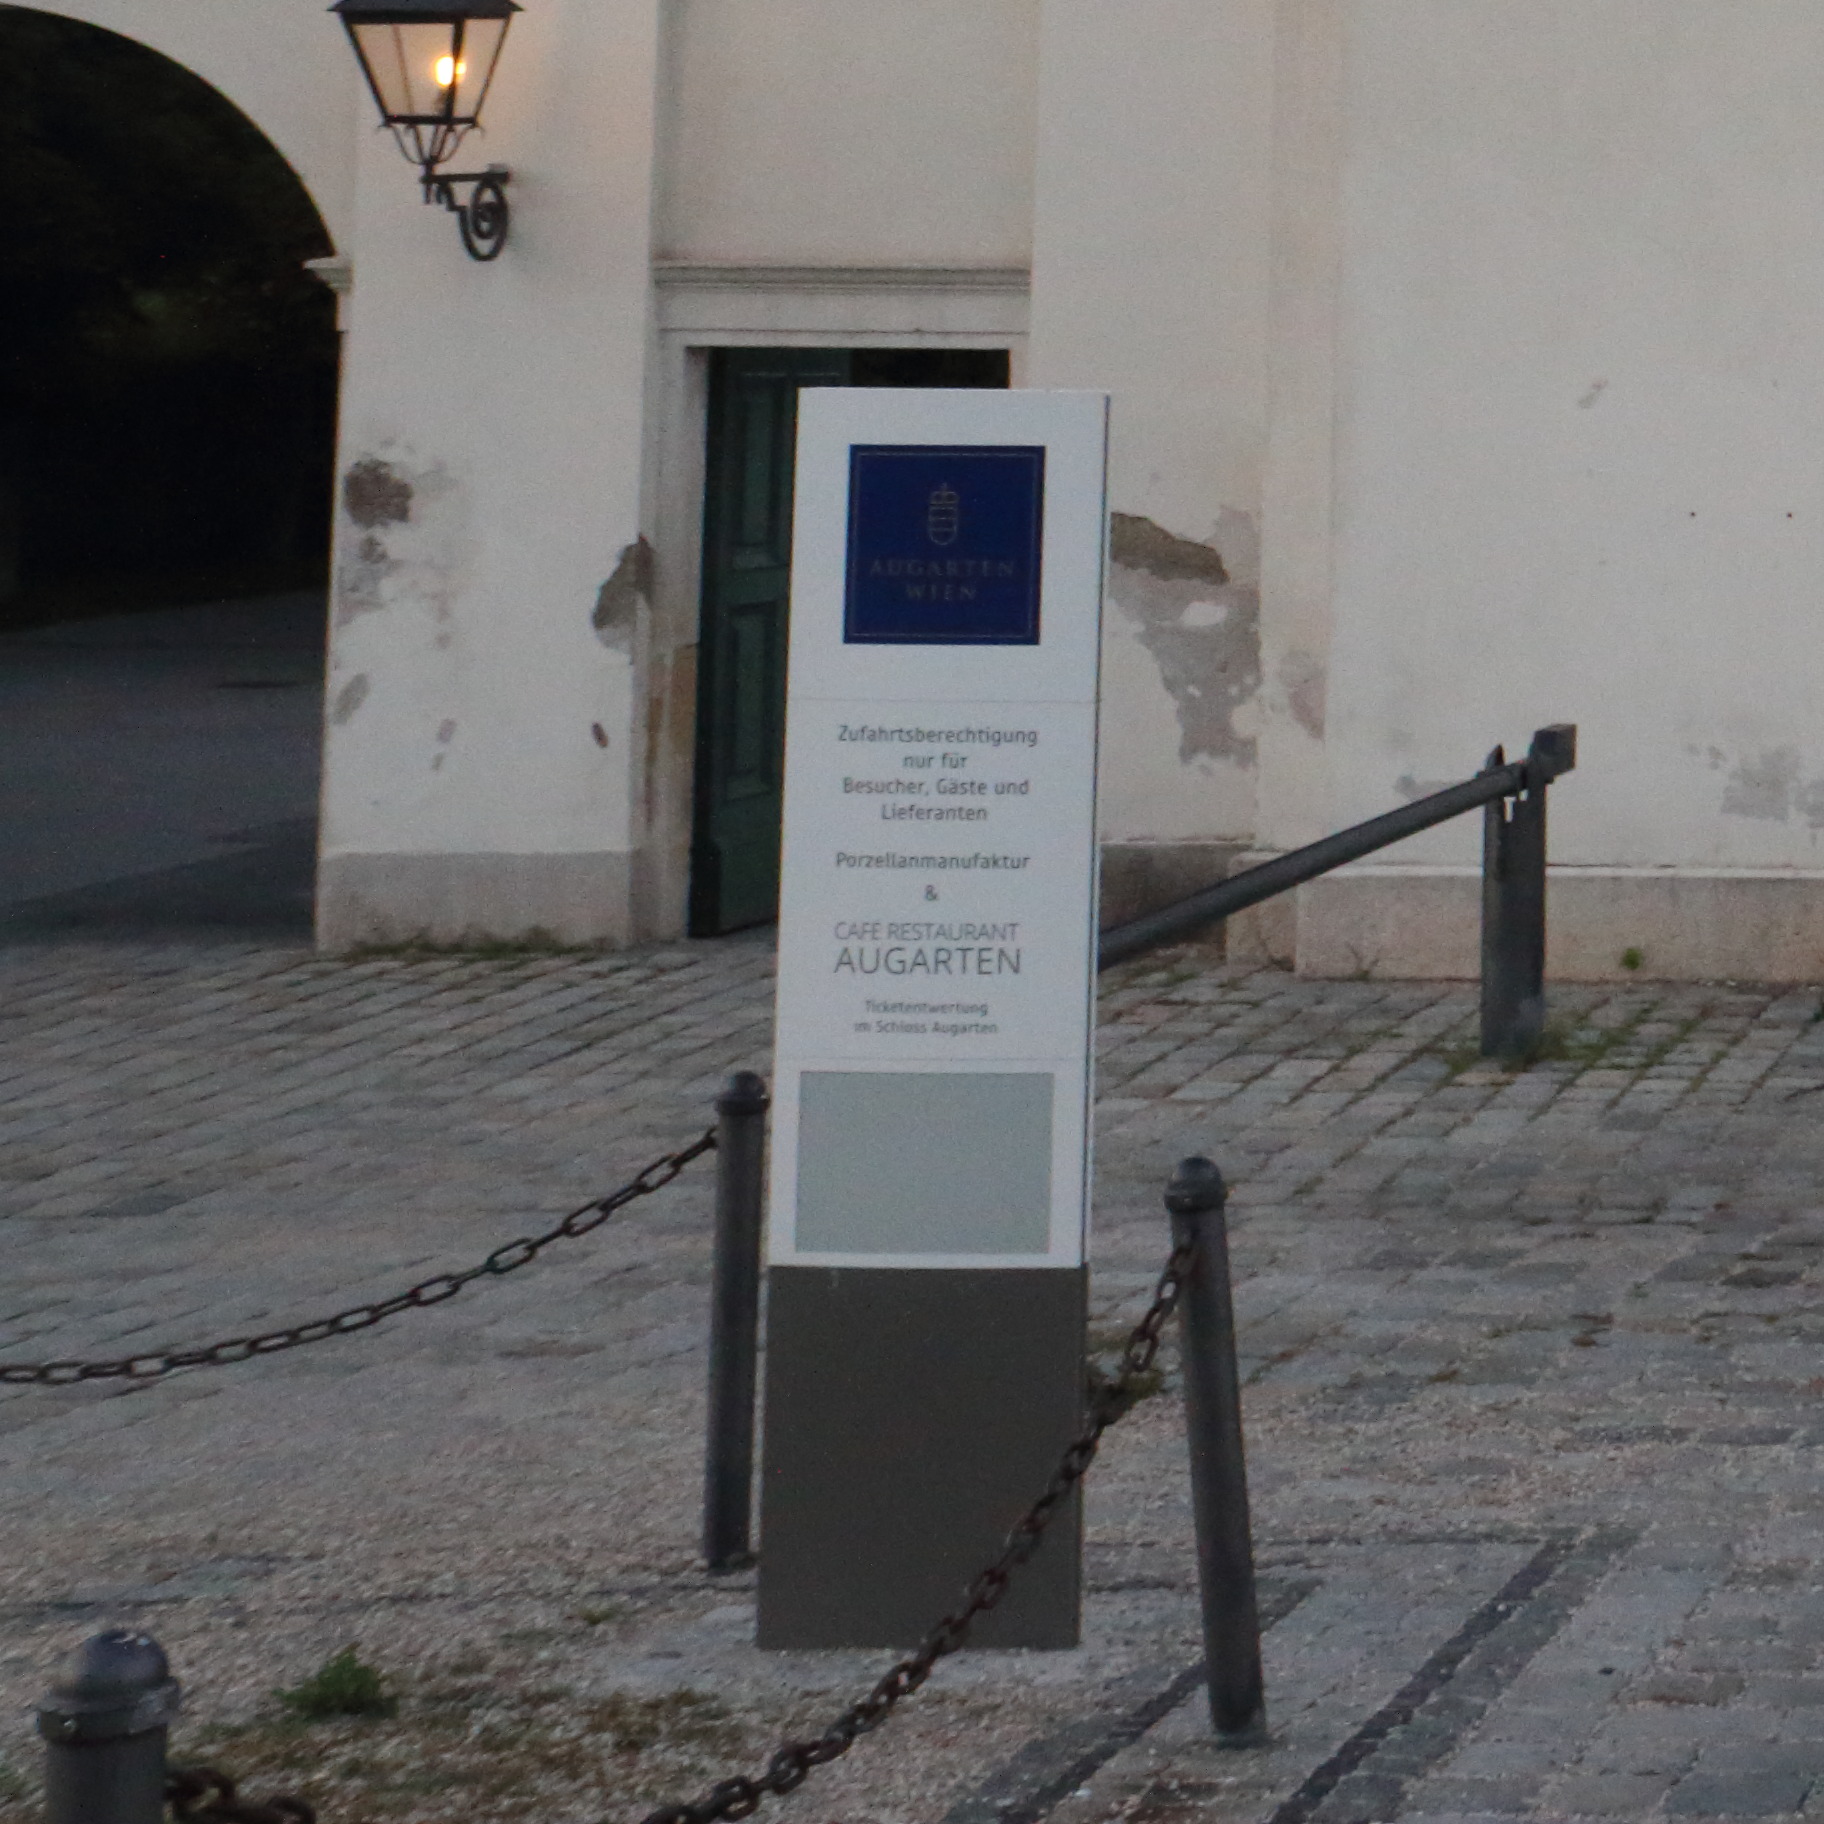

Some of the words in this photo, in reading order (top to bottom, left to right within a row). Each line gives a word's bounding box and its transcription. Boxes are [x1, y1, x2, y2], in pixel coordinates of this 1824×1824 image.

[869, 559, 1016, 578] AUGARTEN
[905, 583, 978, 601] WIEN
[838, 725, 1038, 747] Zufahrtsberechtigung
[902, 754, 935, 769] nur
[940, 751, 968, 769] für
[842, 777, 930, 797] Besucher,
[936, 778, 987, 795] Gäste
[994, 780, 1029, 795] und
[881, 803, 987, 821] Lieferanten
[836, 852, 1030, 870] Porzellanmanufaktur
[925, 884, 939, 901] &
[887, 922, 1020, 941] RESTAURANT
[834, 947, 1021, 975] AUGARTEN
[865, 999, 989, 1016] Ticketentwertung
[876, 1020, 928, 1034] Schloss
[932, 1022, 998, 1036] Augarten
